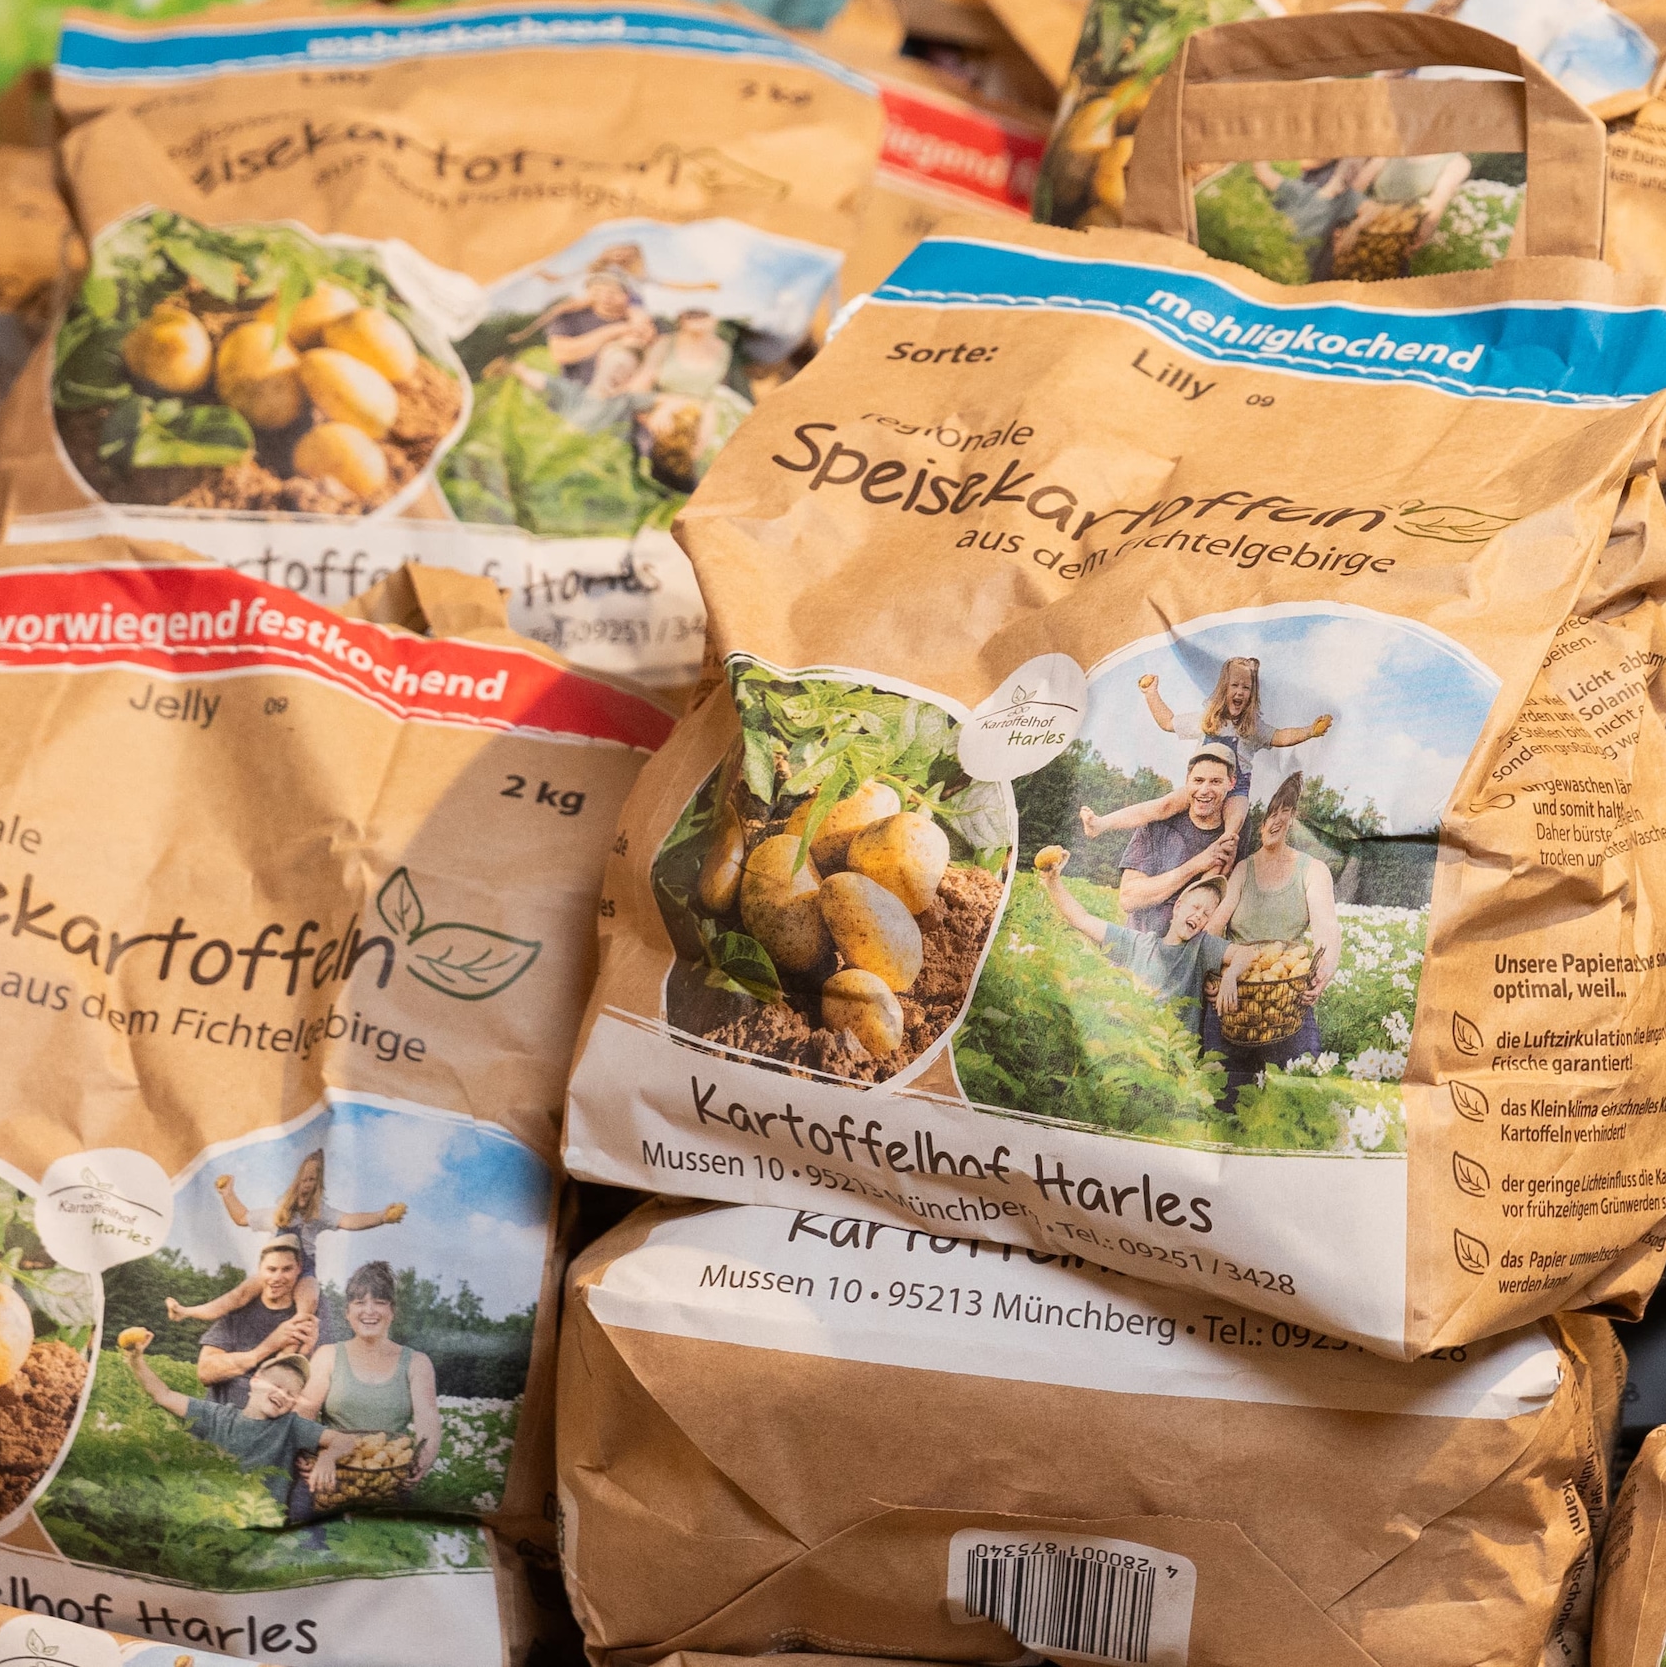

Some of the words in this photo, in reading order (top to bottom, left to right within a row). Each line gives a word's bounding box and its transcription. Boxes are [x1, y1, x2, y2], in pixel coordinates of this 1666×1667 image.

[1145, 286, 1484, 374] mehligkochend
[886, 339, 998, 367] Sorte:
[1130, 346, 1214, 404] Lilly
[859, 411, 1036, 454] regionale
[955, 525, 1025, 555] aus
[1034, 545, 1108, 582] dem
[244, 597, 510, 703] festkochend
[1568, 669, 1616, 703] Licht
[129, 682, 222, 728] Jelly
[981, 716, 1056, 730] Kartoffelhof
[1594, 707, 1639, 739] nicht
[1007, 730, 1065, 746] Harles
[500, 773, 526, 799] 2
[535, 780, 586, 817] kg
[1533, 798, 1558, 817] und
[1559, 800, 1595, 818] somit
[1536, 822, 1571, 843] Daher
[1540, 848, 1585, 868] trocken
[1494, 953, 1558, 974] Unsere
[1493, 978, 1573, 1003] optimal,
[1577, 977, 1627, 999] weil...
[0, 970, 70, 1013] aus
[80, 990, 160, 1037] dem
[171, 1004, 428, 1064] Fichtelgebirge
[1496, 1031, 1521, 1049] die
[1523, 1028, 1633, 1049] Luftzirkulation
[1491, 1053, 1549, 1073] Frische
[1551, 1053, 1634, 1075] garantiert!
[1500, 1097, 1527, 1117] das
[1530, 1098, 1598, 1119] Kleinklima
[1500, 1123, 1573, 1143] Kartoffeln
[1573, 1122, 1627, 1143] verhindert!
[690, 1075, 1011, 1185] Kartoffelhof
[1035, 1153, 1215, 1236] Harles
[642, 1140, 746, 1179] Mussen
[751, 1155, 785, 1183] 10
[1055, 1220, 1115, 1254] Tel.:
[1501, 1173, 1525, 1193] der
[1527, 1177, 1581, 1198] geringe
[1581, 1169, 1637, 1193] Lichteinfluss
[1638, 1168, 1654, 1186] die
[1502, 1202, 1524, 1219] vor
[1526, 1199, 1599, 1222] frühzeitigem
[1600, 1195, 1661, 1215] Grünwerden
[91, 1218, 152, 1247] Harles
[1500, 1249, 1524, 1269] das
[1529, 1250, 1568, 1273] Papier
[1498, 1274, 1542, 1294] werden
[699, 1263, 815, 1299] Mussen
[828, 1276, 863, 1305] 10
[887, 1281, 984, 1319] 95213
[992, 1287, 1178, 1346] Münchberg
[1202, 1313, 1264, 1348] Tel.:
[975, 1542, 1058, 1559] 875340
[1069, 1545, 1151, 1574] 280001
[133, 1597, 321, 1656] Harles
